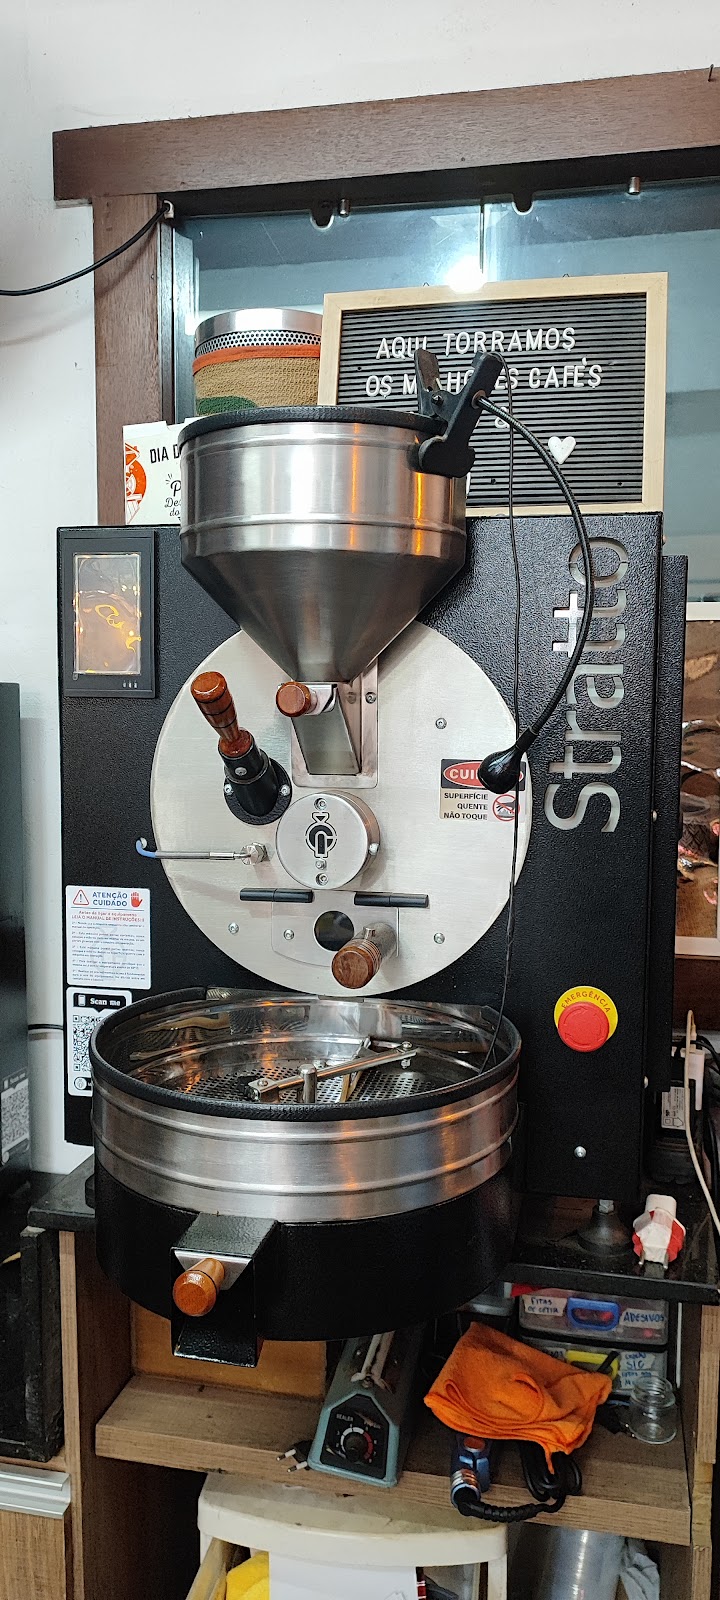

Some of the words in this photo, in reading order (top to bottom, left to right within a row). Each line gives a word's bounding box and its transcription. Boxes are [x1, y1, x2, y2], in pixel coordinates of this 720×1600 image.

[443, 327, 576, 357] TORRAMOS
[365, 375, 393, 398] OS
[529, 357, 602, 389] CAFÉS
[149, 446, 170, 464] DIA
[544, 536, 629, 833] Stratto
[444, 792, 489, 801] SUPERFÍCIE
[457, 802, 488, 811] QUENTE
[443, 810, 461, 819] NÃO
[92, 891, 128, 900] ATENÇÃO
[92, 899, 128, 907] CUIDADO
[90, 997, 107, 1006] Scan
[561, 990, 611, 1012] EMERGÊNCIA
[623, 1311, 665, 1323] ADESIVOS
